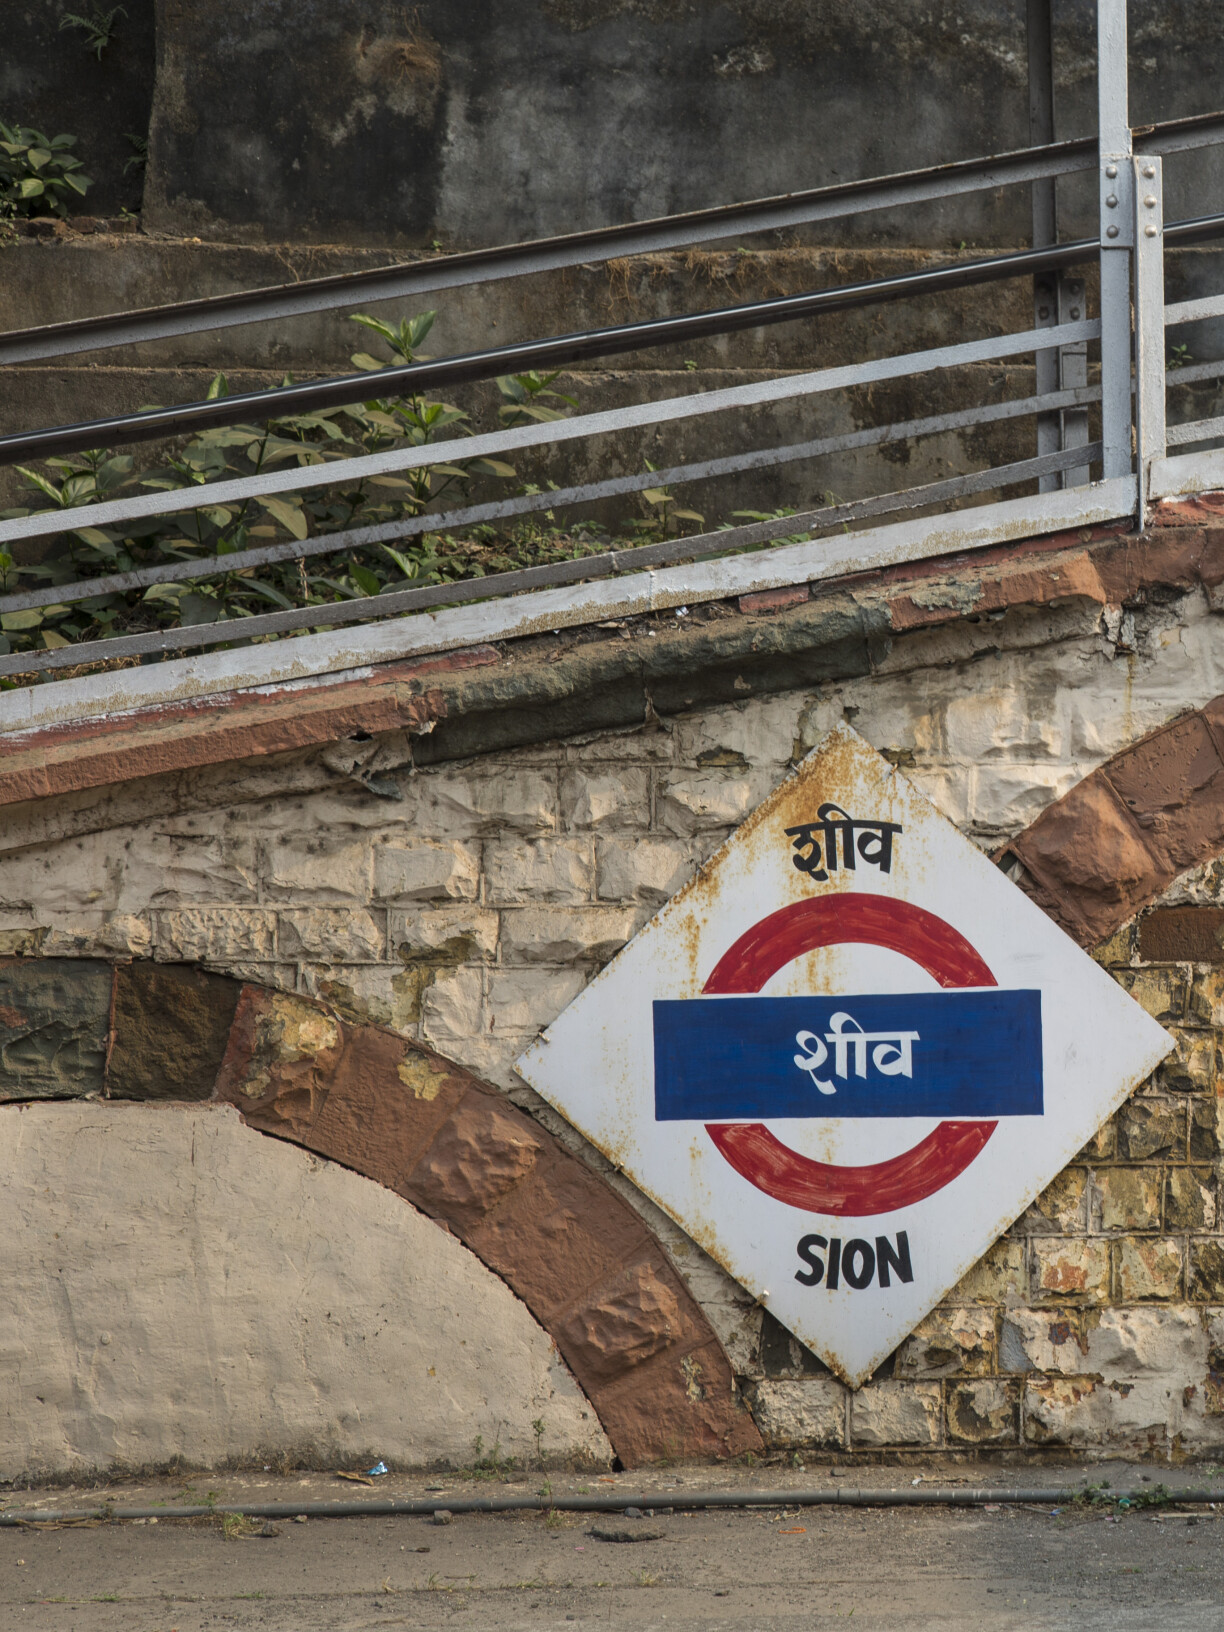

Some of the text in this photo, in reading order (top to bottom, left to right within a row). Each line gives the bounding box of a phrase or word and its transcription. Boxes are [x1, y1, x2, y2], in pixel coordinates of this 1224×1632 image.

[784, 803, 902, 881] शीव
[794, 1012, 920, 1094] शीव
[795, 1230, 913, 1290] SION
